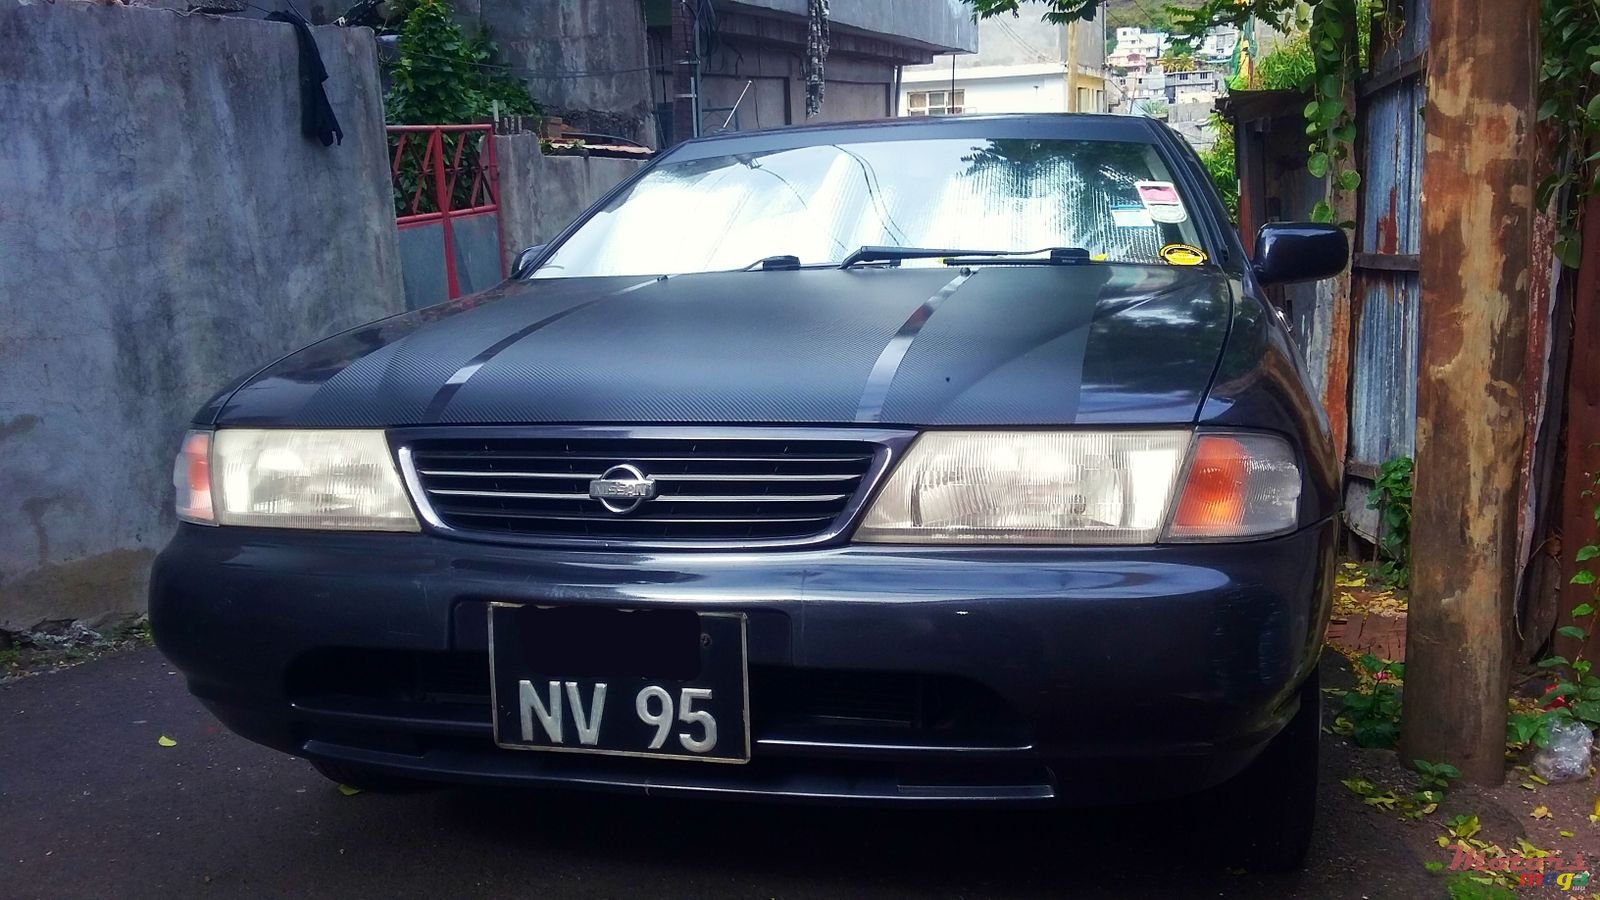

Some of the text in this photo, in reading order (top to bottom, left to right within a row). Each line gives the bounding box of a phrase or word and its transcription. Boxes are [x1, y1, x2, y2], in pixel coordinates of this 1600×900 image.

[594, 481, 647, 497] NISSAN
[519, 680, 718, 753] NV 95
